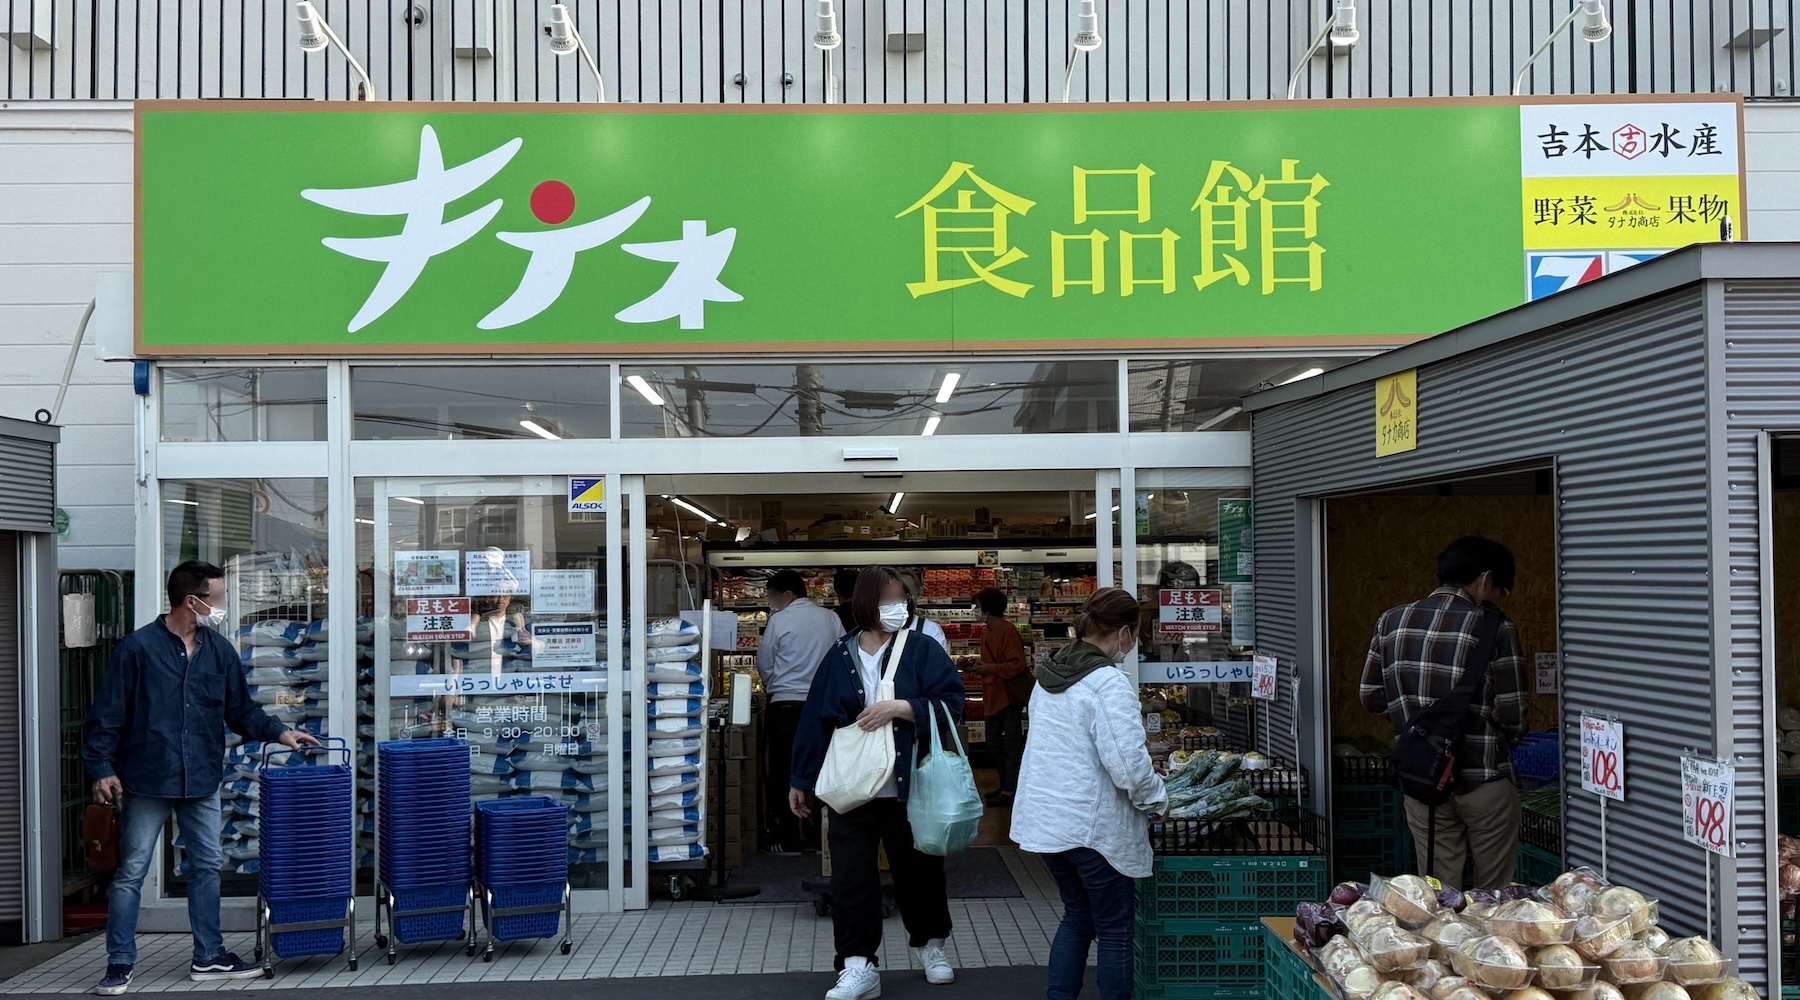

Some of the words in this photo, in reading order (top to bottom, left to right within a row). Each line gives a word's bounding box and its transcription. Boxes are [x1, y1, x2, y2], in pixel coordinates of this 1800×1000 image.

[1537, 123, 1611, 159] 吉本
[1648, 122, 1722, 158] 水産
[1533, 195, 1597, 226] 野菜
[1665, 193, 1728, 225] 果物
[300, 124, 745, 333] キテネ
[895, 159, 1331, 298] 食品館
[1608, 215, 1660, 228] タナカ商店
[1169, 591, 1210, 605] 足もと
[416, 600, 459, 614] 足もと
[1175, 607, 1205, 621] 注意
[423, 616, 454, 631] 注意
[444, 675, 574, 692] いらっしゃいませ
[475, 705, 548, 724] 営業時間
[542, 744, 579, 756] 月曜日
